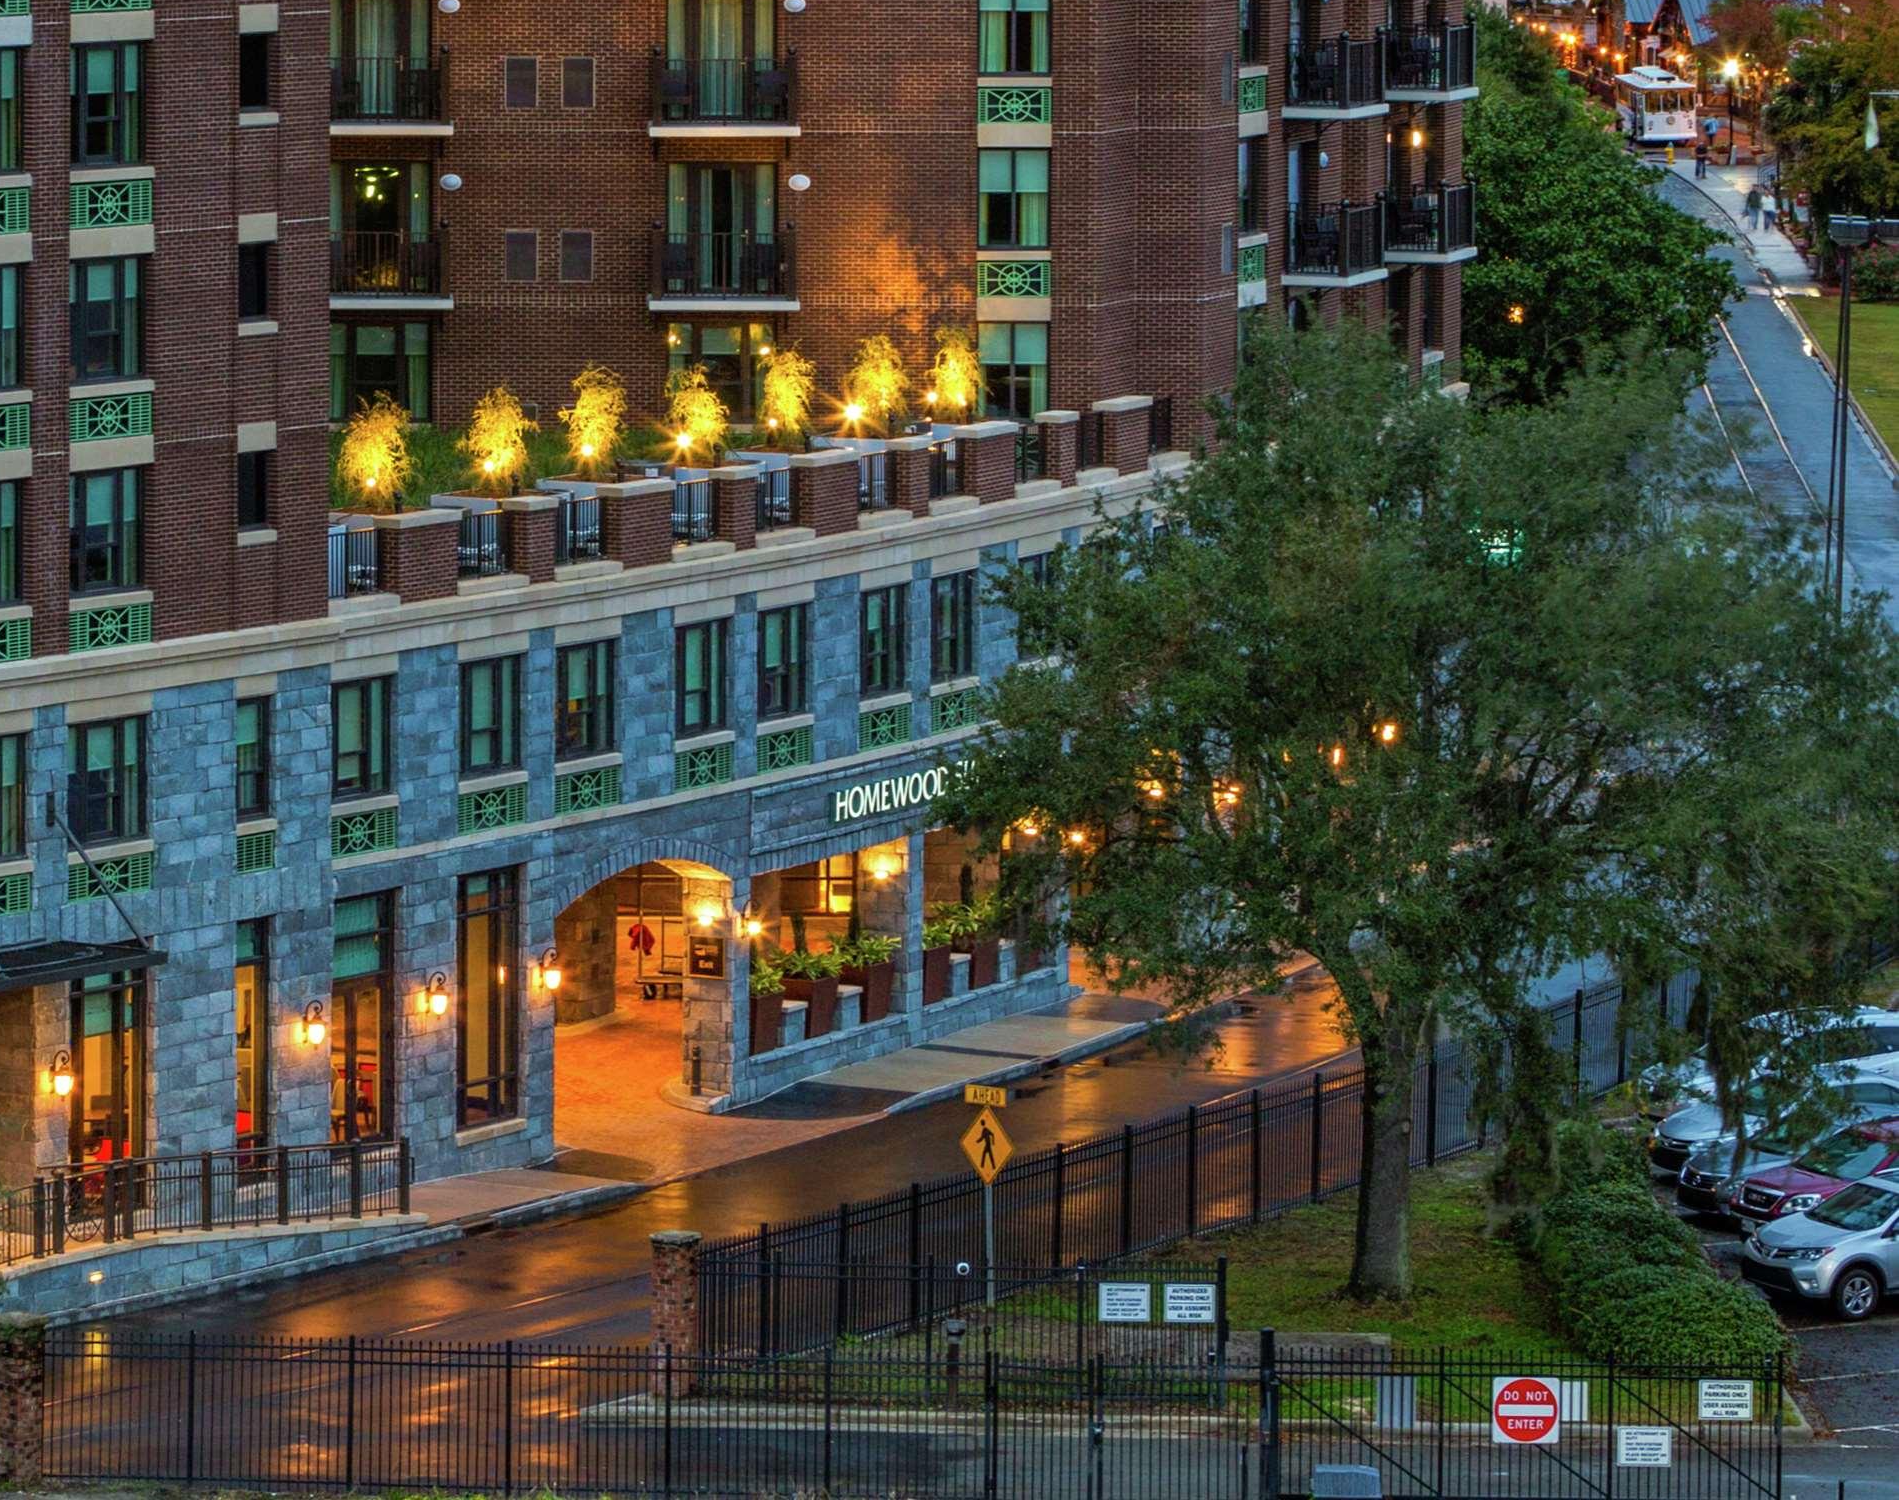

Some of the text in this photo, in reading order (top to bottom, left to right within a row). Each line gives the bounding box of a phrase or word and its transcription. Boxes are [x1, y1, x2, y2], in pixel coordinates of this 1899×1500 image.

[835, 766, 948, 822] HOMEWOOD
[973, 1088, 1001, 1104] AHEAD
[1504, 1391, 1549, 1401] DO NOT
[1507, 1419, 1544, 1430] ENTER
